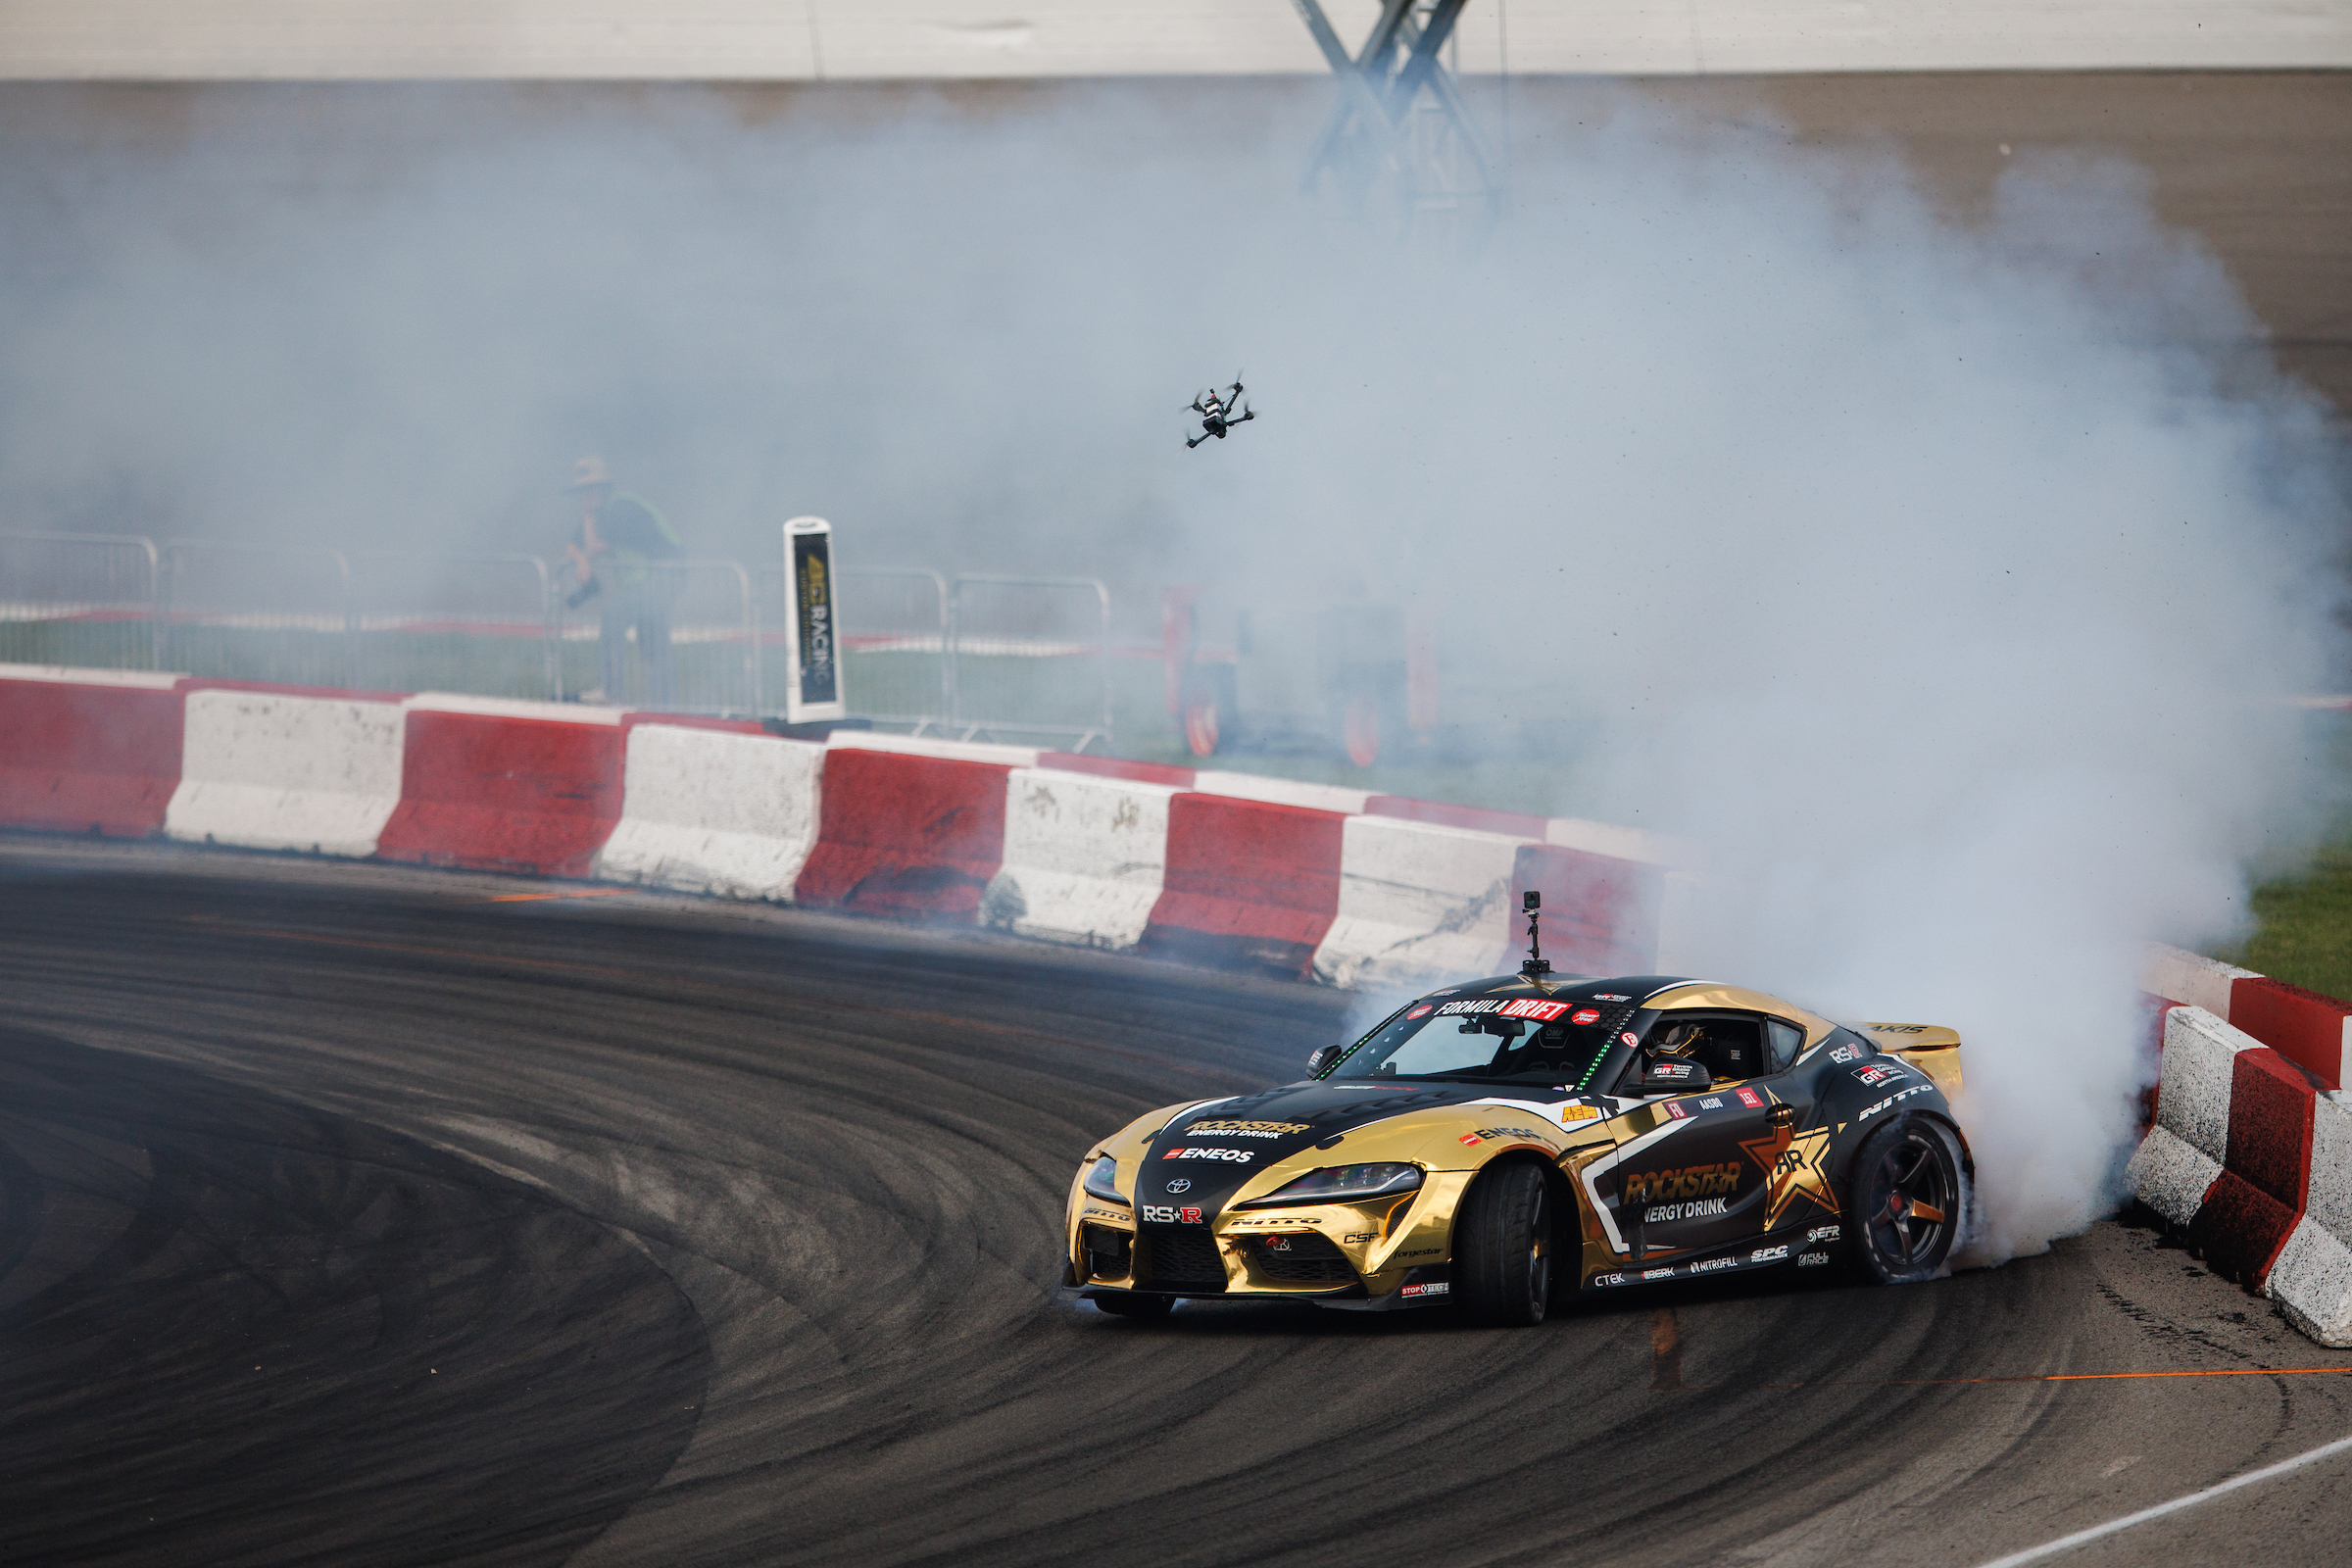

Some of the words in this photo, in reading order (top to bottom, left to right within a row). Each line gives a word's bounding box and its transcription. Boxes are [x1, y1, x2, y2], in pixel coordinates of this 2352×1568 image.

[809, 605, 830, 685] RACING
[1434, 1000, 1510, 1016] FORMULA
[1508, 999, 1568, 1019] DRIFT
[1860, 1068, 1886, 1085] GR
[1698, 1098, 1724, 1110] AASBO
[1740, 1093, 1758, 1104] 151
[1858, 1085, 1934, 1122] NITTO
[1668, 1103, 1685, 1117] FD
[1183, 1120, 1311, 1135] ROCKSTAR
[1474, 1128, 1542, 1141] ENEOS
[1238, 1130, 1284, 1140] DRINK
[1178, 1148, 1254, 1163] ENEOS
[1624, 1161, 1742, 1205] ROCKSTAR
[1686, 1197, 1728, 1218] DRINK
[1344, 1232, 1379, 1244] CSF
[1817, 1225, 1840, 1239] EFR
[1394, 1248, 1444, 1260] forgestar
[1750, 1245, 1788, 1259] SPC
[1699, 1256, 1738, 1272] NITROFILL
[1806, 1256, 1829, 1266] RACE
[1594, 1272, 1626, 1287] CTEK
